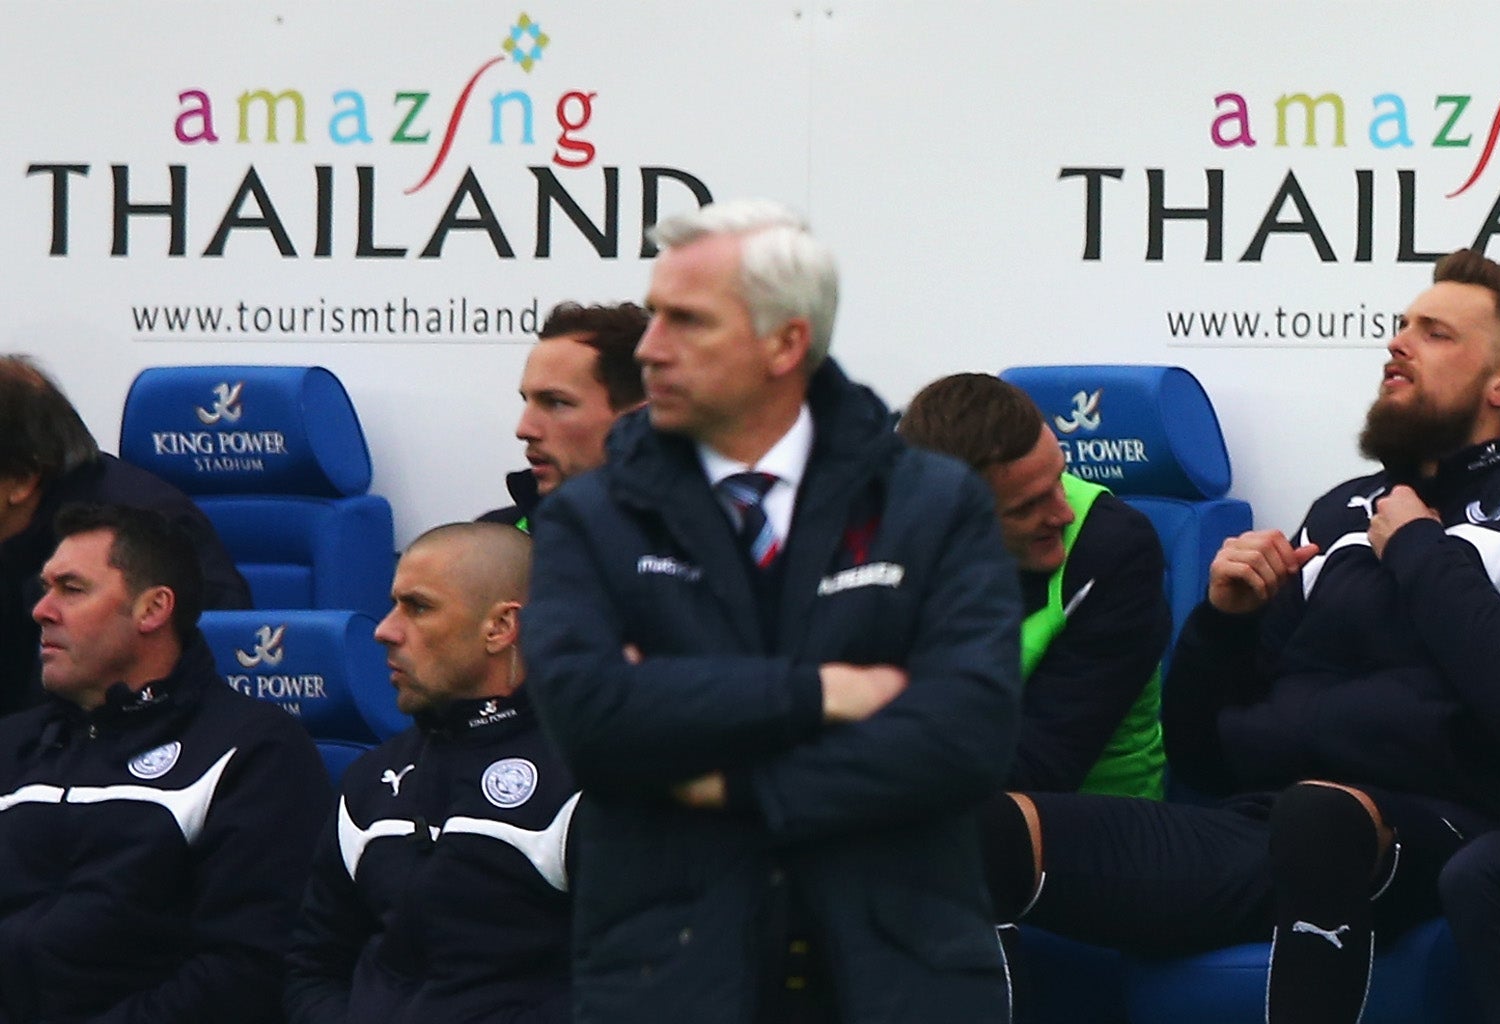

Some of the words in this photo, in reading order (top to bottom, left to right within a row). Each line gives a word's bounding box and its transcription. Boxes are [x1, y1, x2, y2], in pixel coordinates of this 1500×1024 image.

[132, 298, 542, 334] www.tourismthailand
[152, 432, 213, 454] KING
[217, 432, 288, 454] POWER
[1077, 439, 1149, 462] POWER
[194, 457, 264, 472] STADIUM
[257, 675, 327, 698] POWER
